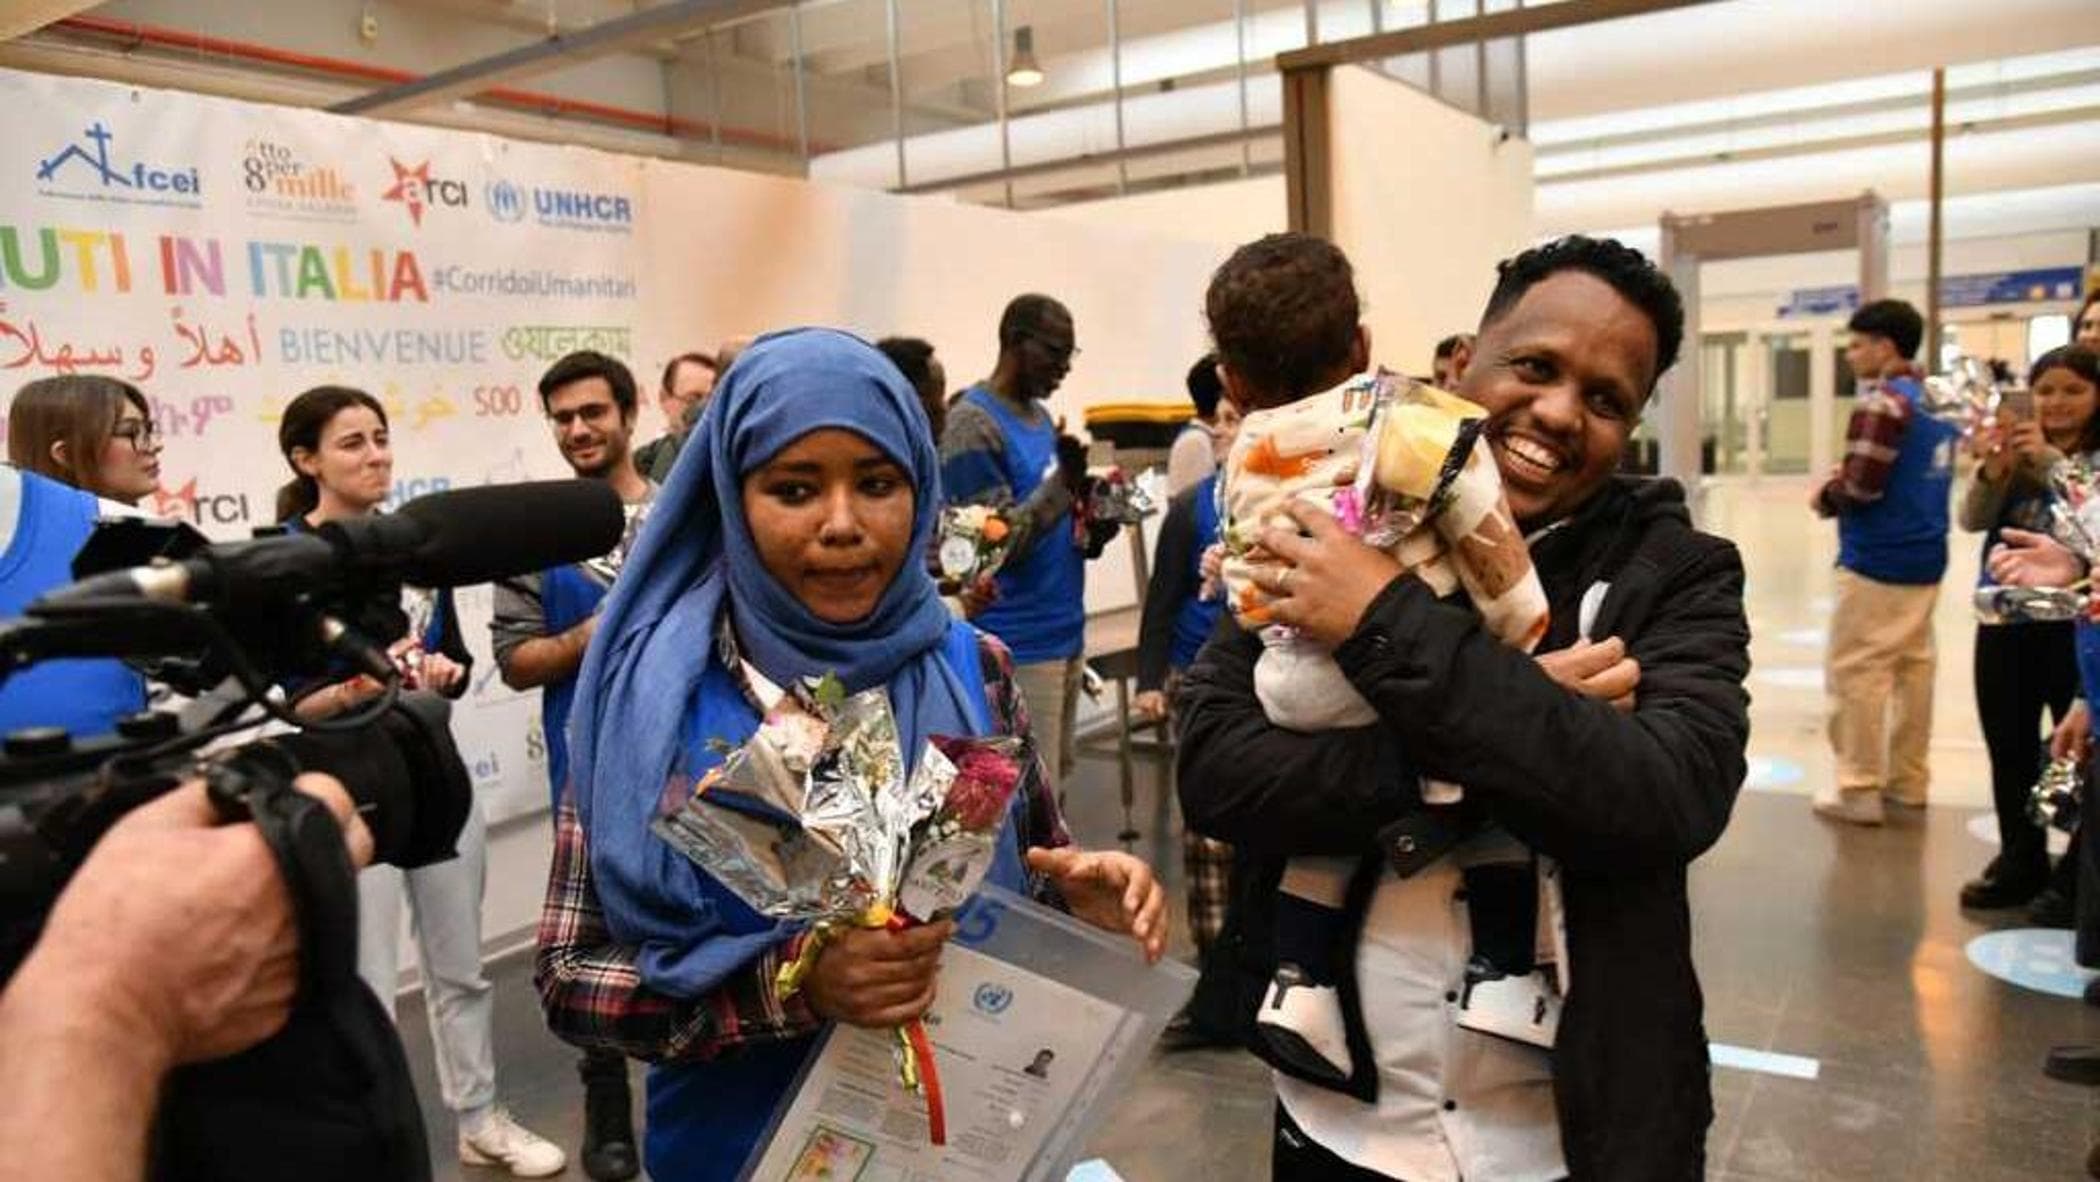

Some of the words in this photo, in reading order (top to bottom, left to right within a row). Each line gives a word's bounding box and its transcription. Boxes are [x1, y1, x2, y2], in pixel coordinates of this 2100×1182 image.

[133, 162, 201, 195] fcei
[534, 188, 633, 223] UNHCR
[0, 225, 132, 295] UTI
[160, 235, 226, 296] IN
[247, 241, 429, 303] ITALIA
[279, 327, 487, 366] BIENVENUE
